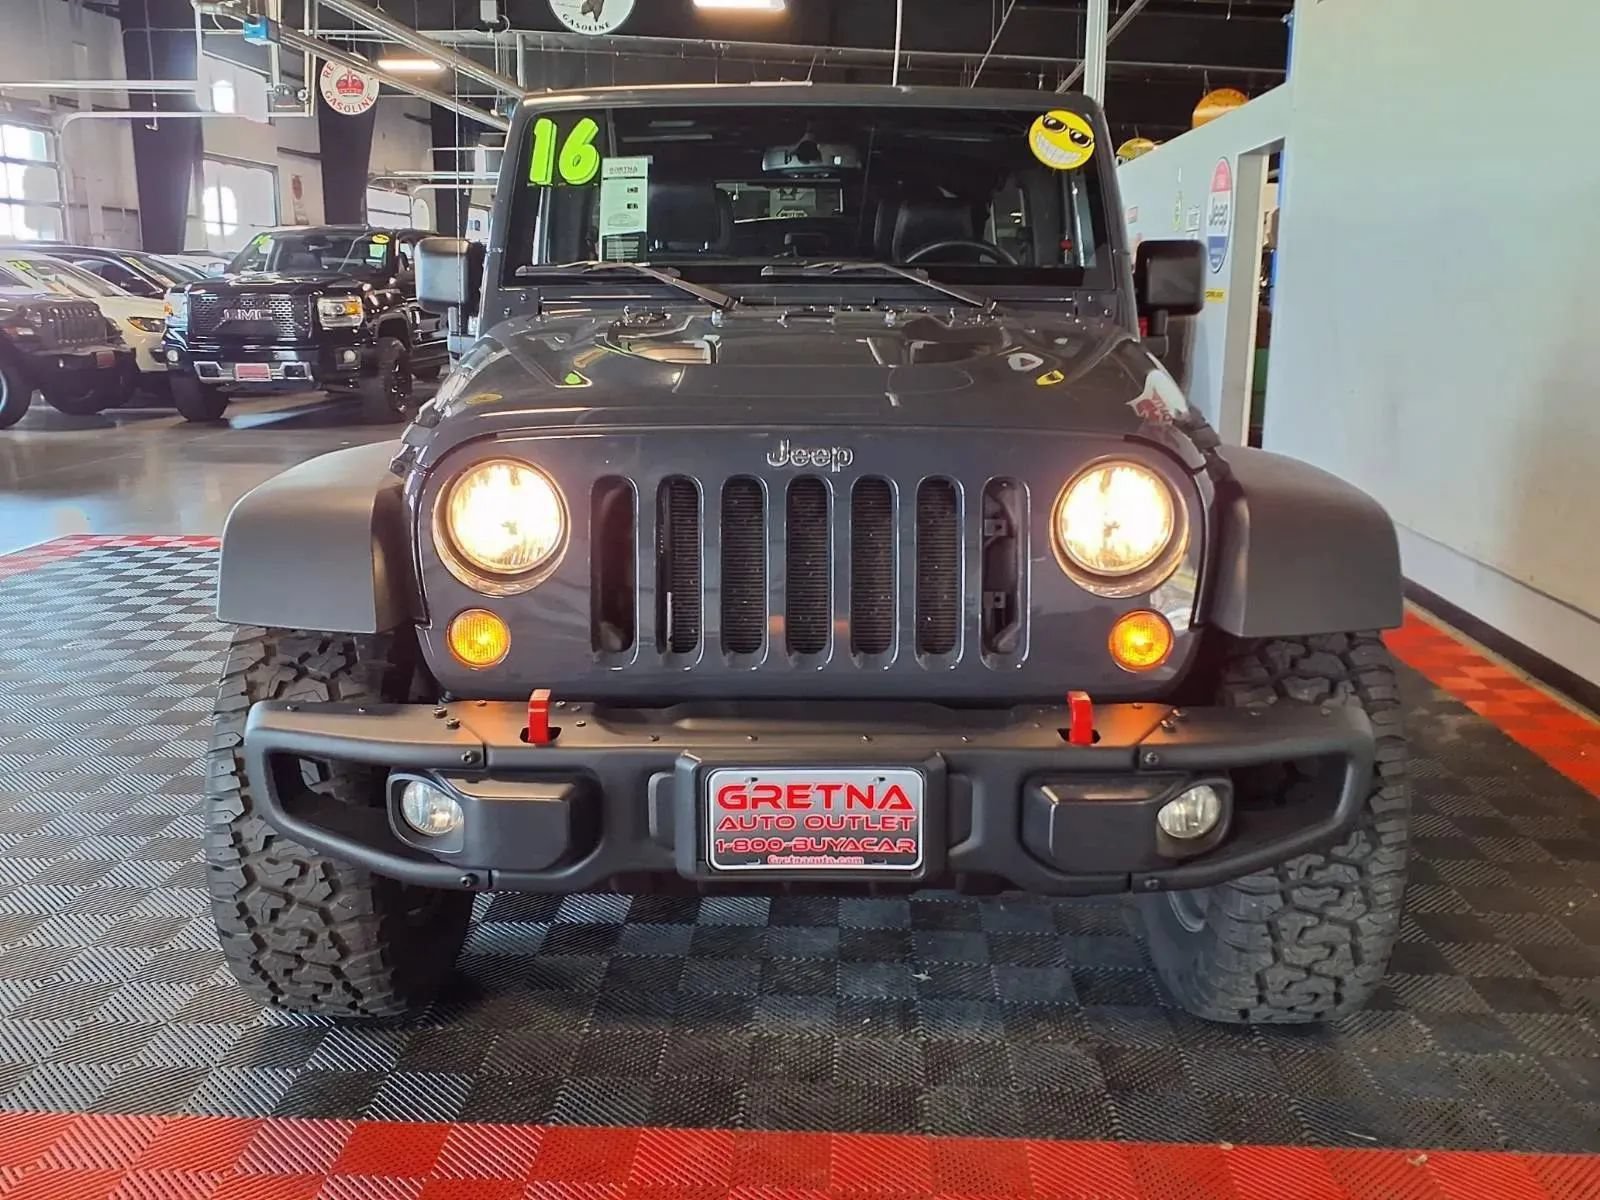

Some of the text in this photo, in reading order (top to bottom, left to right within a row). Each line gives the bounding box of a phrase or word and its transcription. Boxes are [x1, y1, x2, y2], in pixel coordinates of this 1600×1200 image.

[562, 13, 611, 32] GASOLINE
[325, 90, 375, 113] GASOLINE
[529, 117, 600, 185] 16
[1208, 197, 1229, 232] Jeep
[223, 308, 273, 321] GMC
[766, 439, 854, 473] Jeep
[716, 783, 915, 812] GRETNA
[716, 814, 917, 832] AUTO OUTLET
[715, 837, 917, 854] 1-800-BUYACAR
